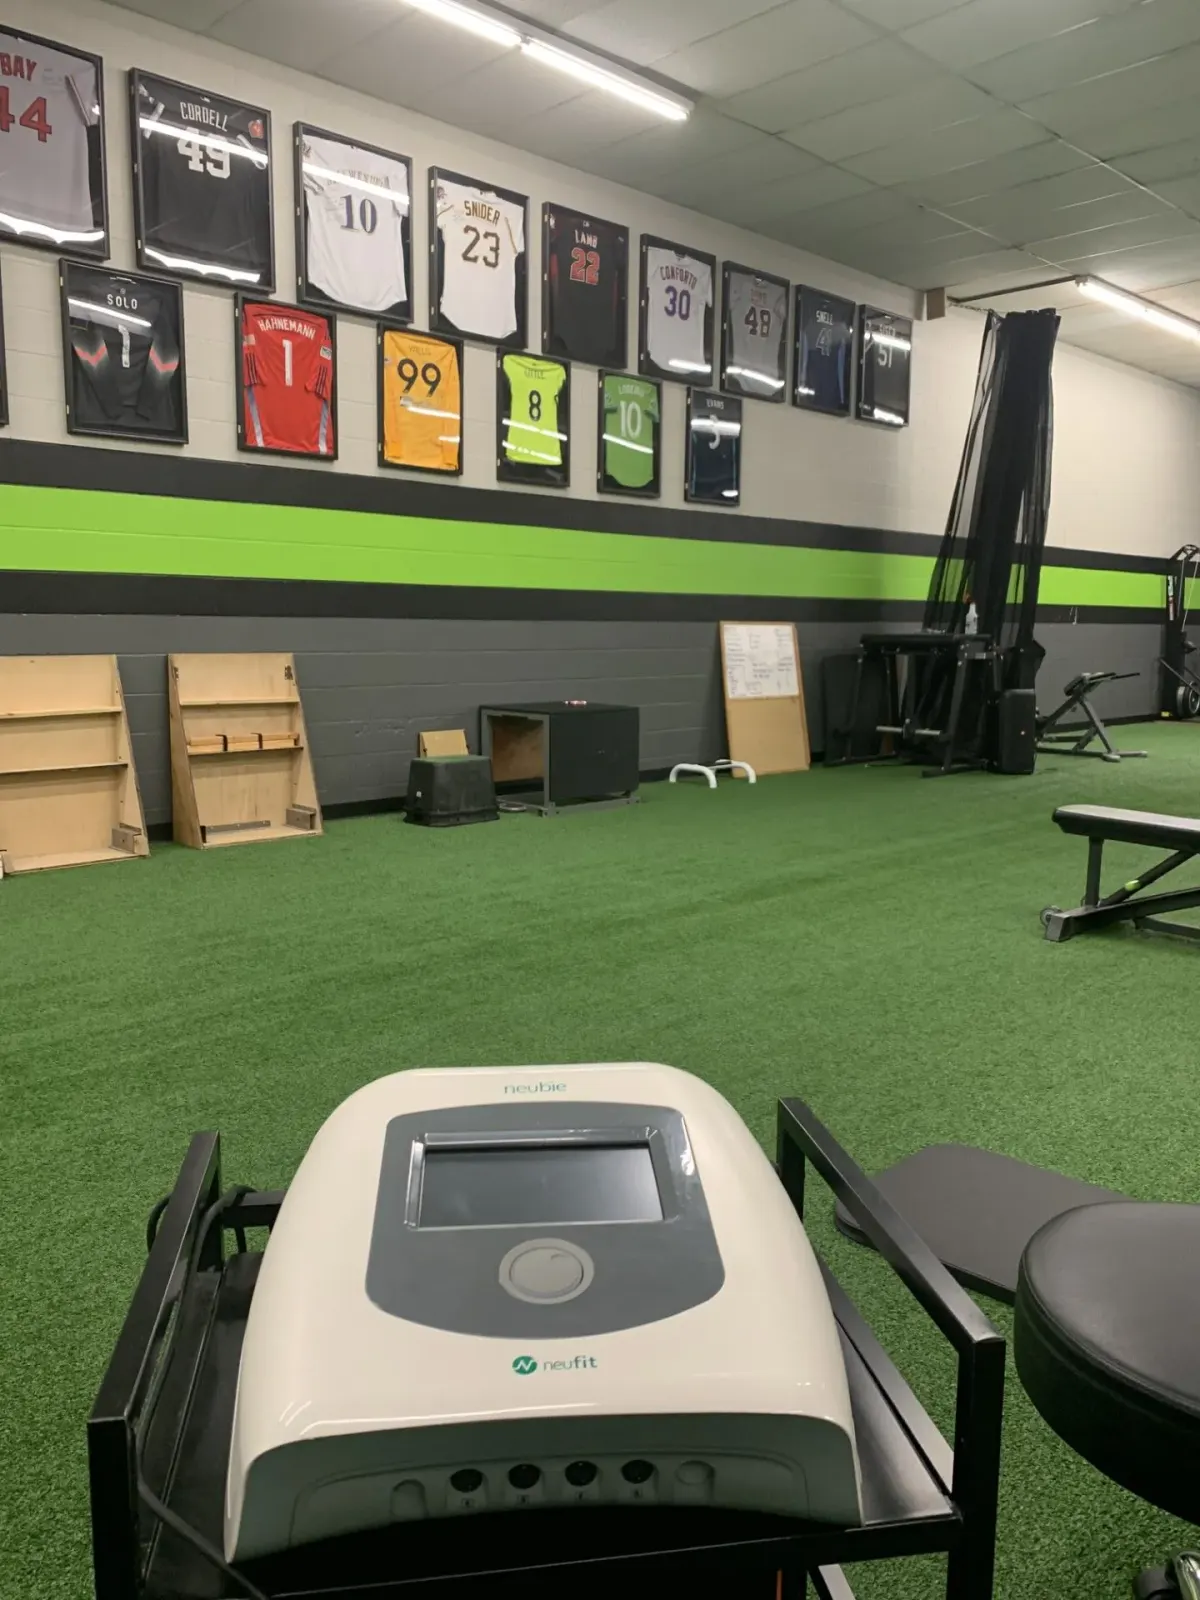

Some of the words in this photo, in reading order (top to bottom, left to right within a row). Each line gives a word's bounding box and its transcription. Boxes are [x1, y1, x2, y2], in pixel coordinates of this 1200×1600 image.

[0, 52, 37, 81] BAY
[180, 101, 228, 132] CORDELL
[177, 126, 231, 179] 49
[340, 194, 377, 234] 10
[464, 200, 501, 226] SNIDER
[461, 225, 501, 268] 23
[575, 229, 598, 249] LAMB
[570, 247, 600, 286] 22
[660, 265, 698, 290] CONFORTO
[107, 293, 138, 310] SOLO
[664, 285, 691, 321] 30
[258, 315, 317, 340] HAHNEMANN
[744, 306, 771, 338] 48
[118, 324, 131, 368] 1
[282, 339, 293, 386] 1
[397, 358, 441, 398] 99
[529, 389, 542, 421] 8
[620, 400, 642, 440] 10
[504, 1081, 567, 1094] neubie
[543, 1355, 598, 1372] neufit
